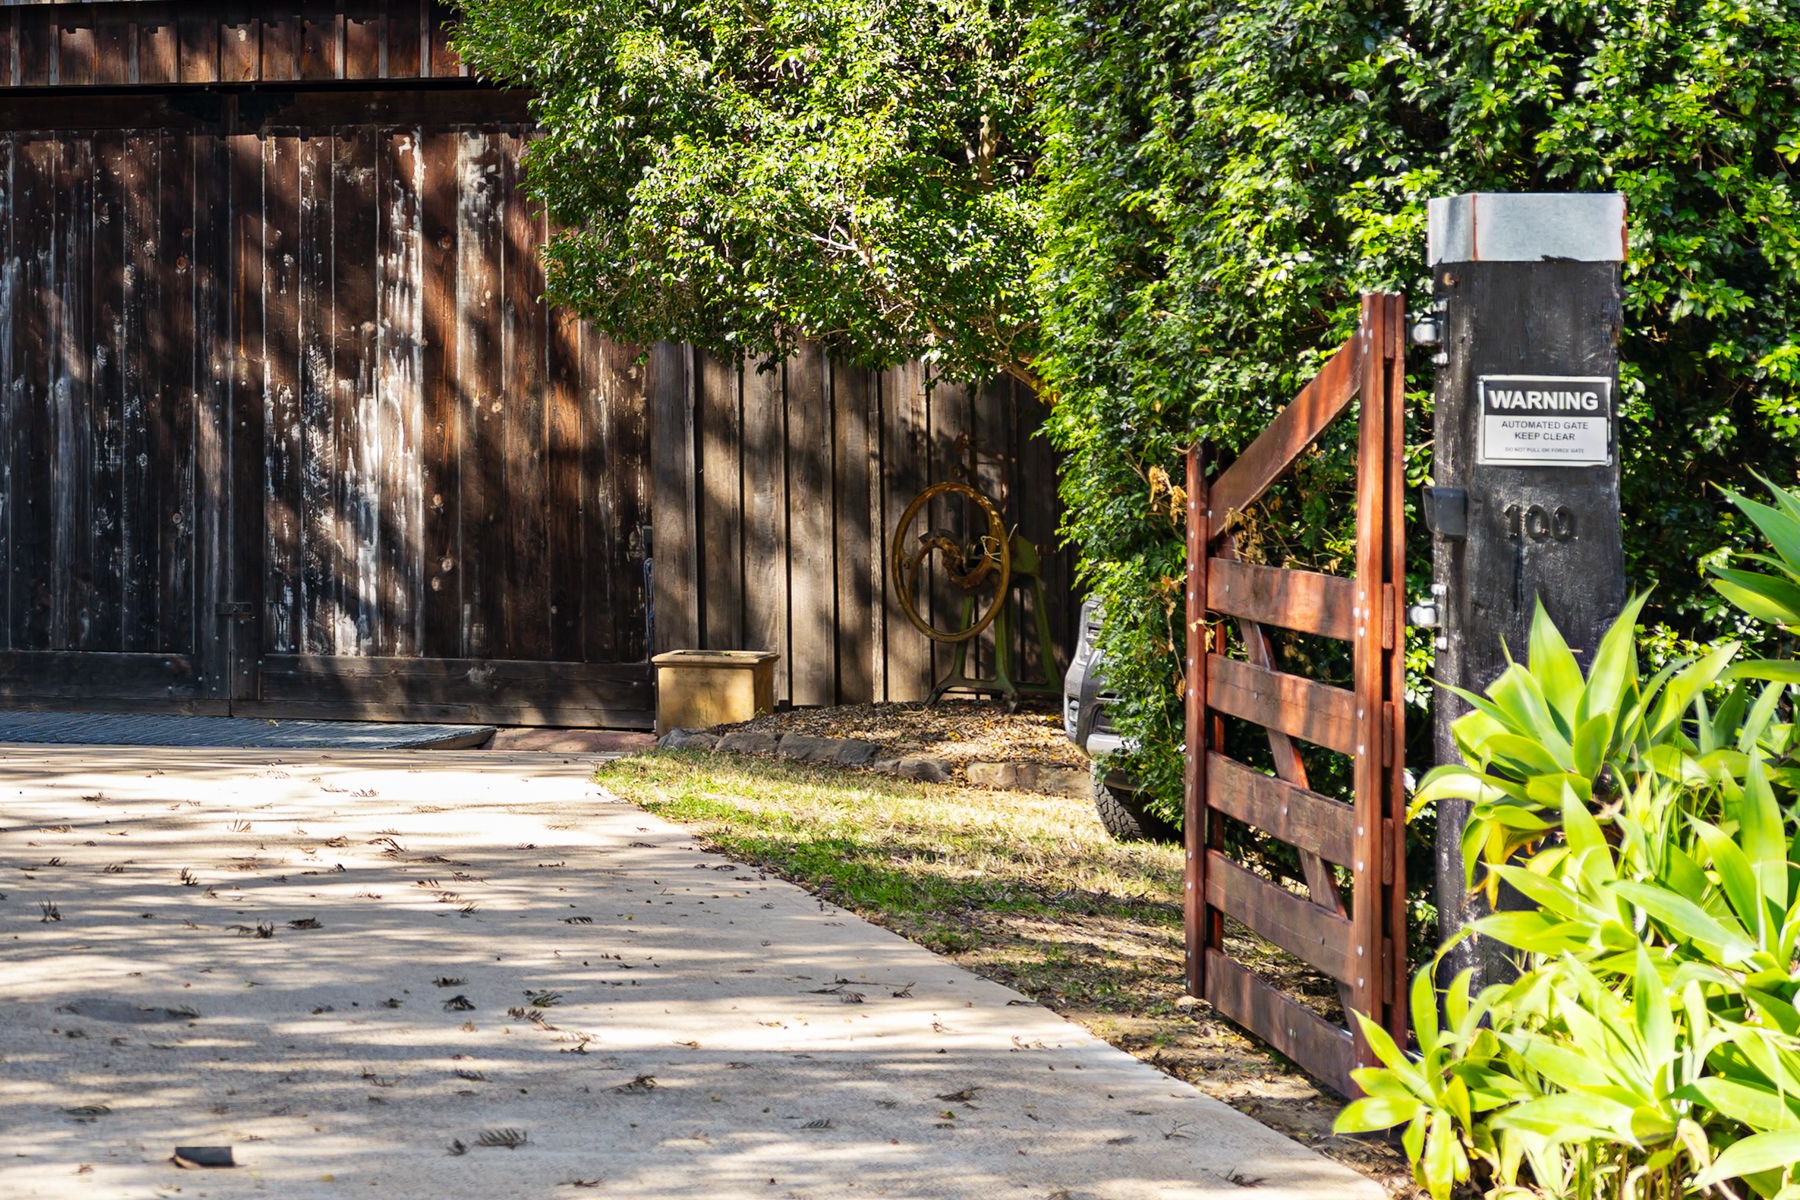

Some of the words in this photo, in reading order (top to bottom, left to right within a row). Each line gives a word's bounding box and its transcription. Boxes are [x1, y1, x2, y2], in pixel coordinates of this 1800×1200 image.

[1489, 390, 1599, 411] WARNING
[1501, 420, 1561, 430] AUTOMATED
[1563, 421, 1589, 430] GATE
[1514, 432, 1540, 440] KEEP
[1543, 432, 1576, 441] CLEAR
[1504, 504, 1575, 542] 100
